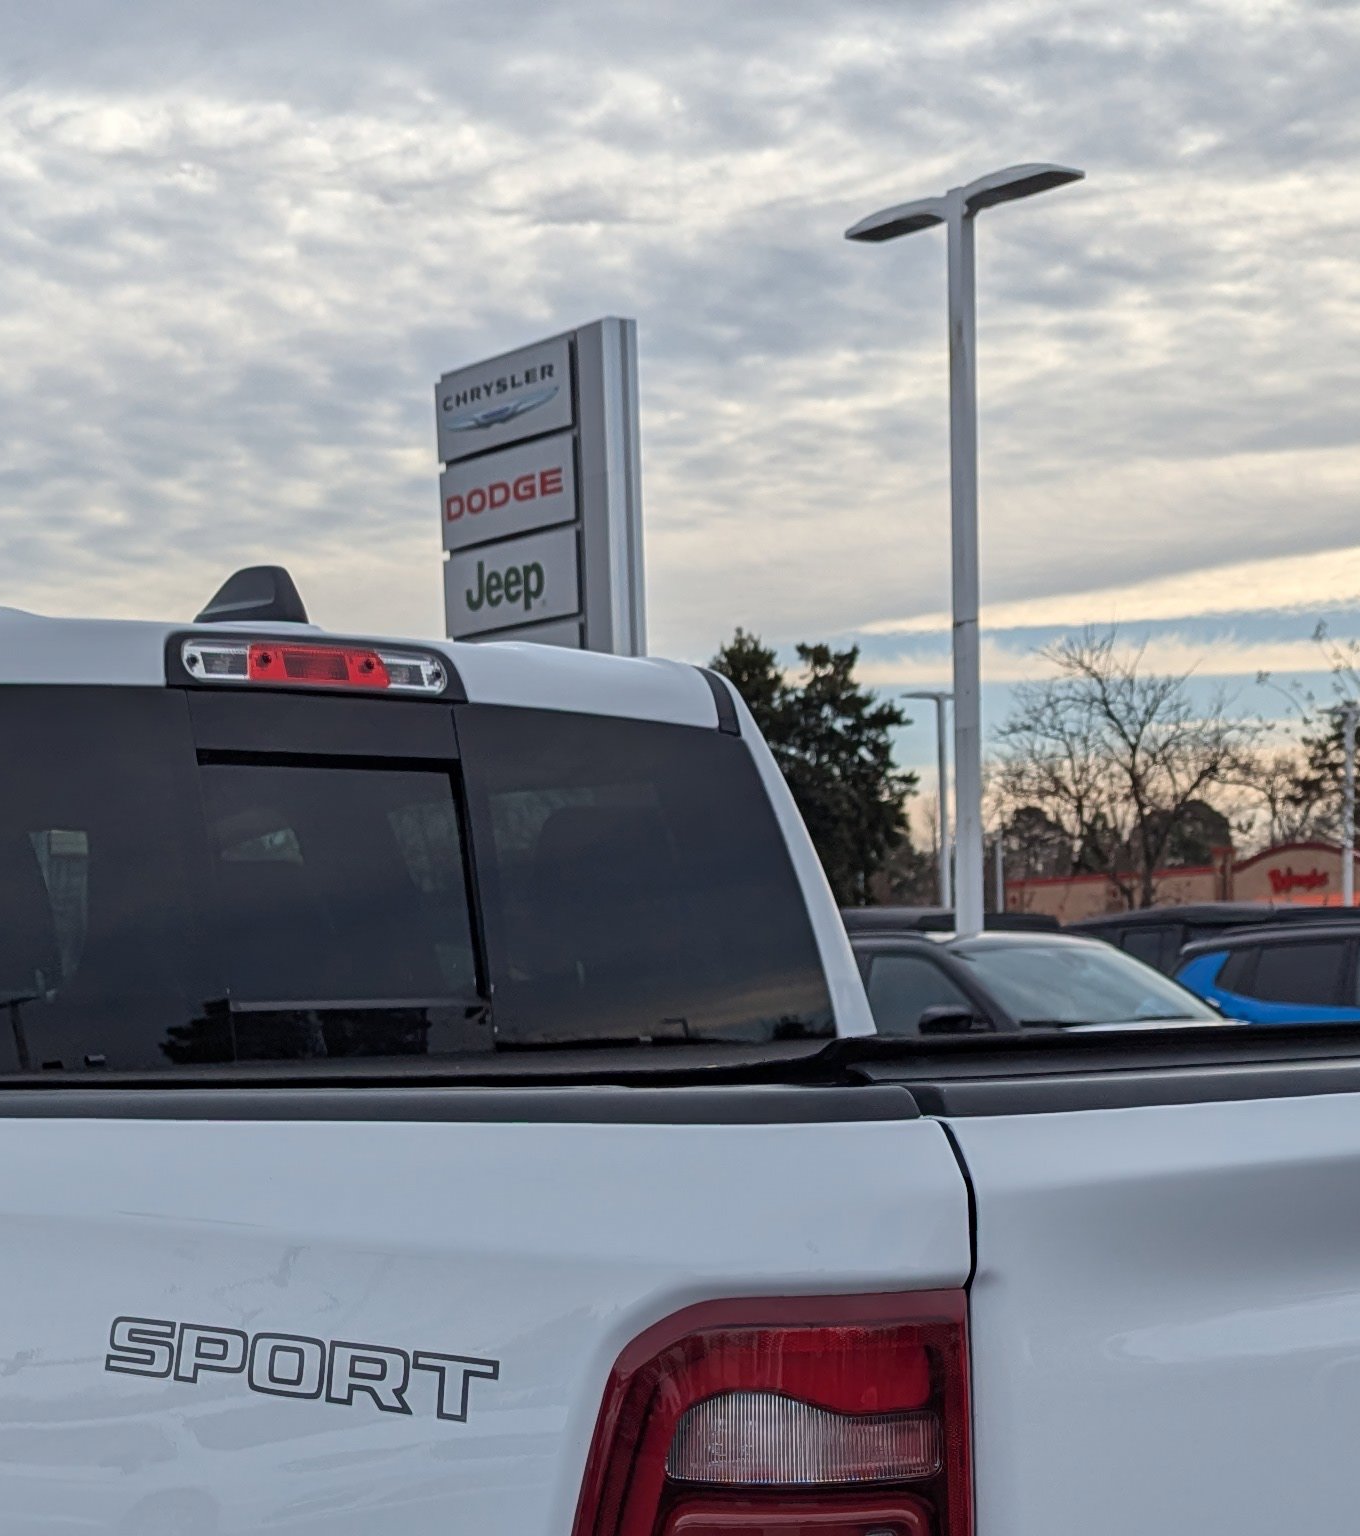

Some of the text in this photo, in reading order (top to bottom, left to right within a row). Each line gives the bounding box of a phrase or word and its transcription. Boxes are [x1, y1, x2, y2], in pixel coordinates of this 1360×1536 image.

[442, 363, 555, 412] CHRYSLER
[445, 466, 564, 523] DODGE
[465, 560, 546, 612] Jeep
[105, 1315, 500, 1423] SPORT
